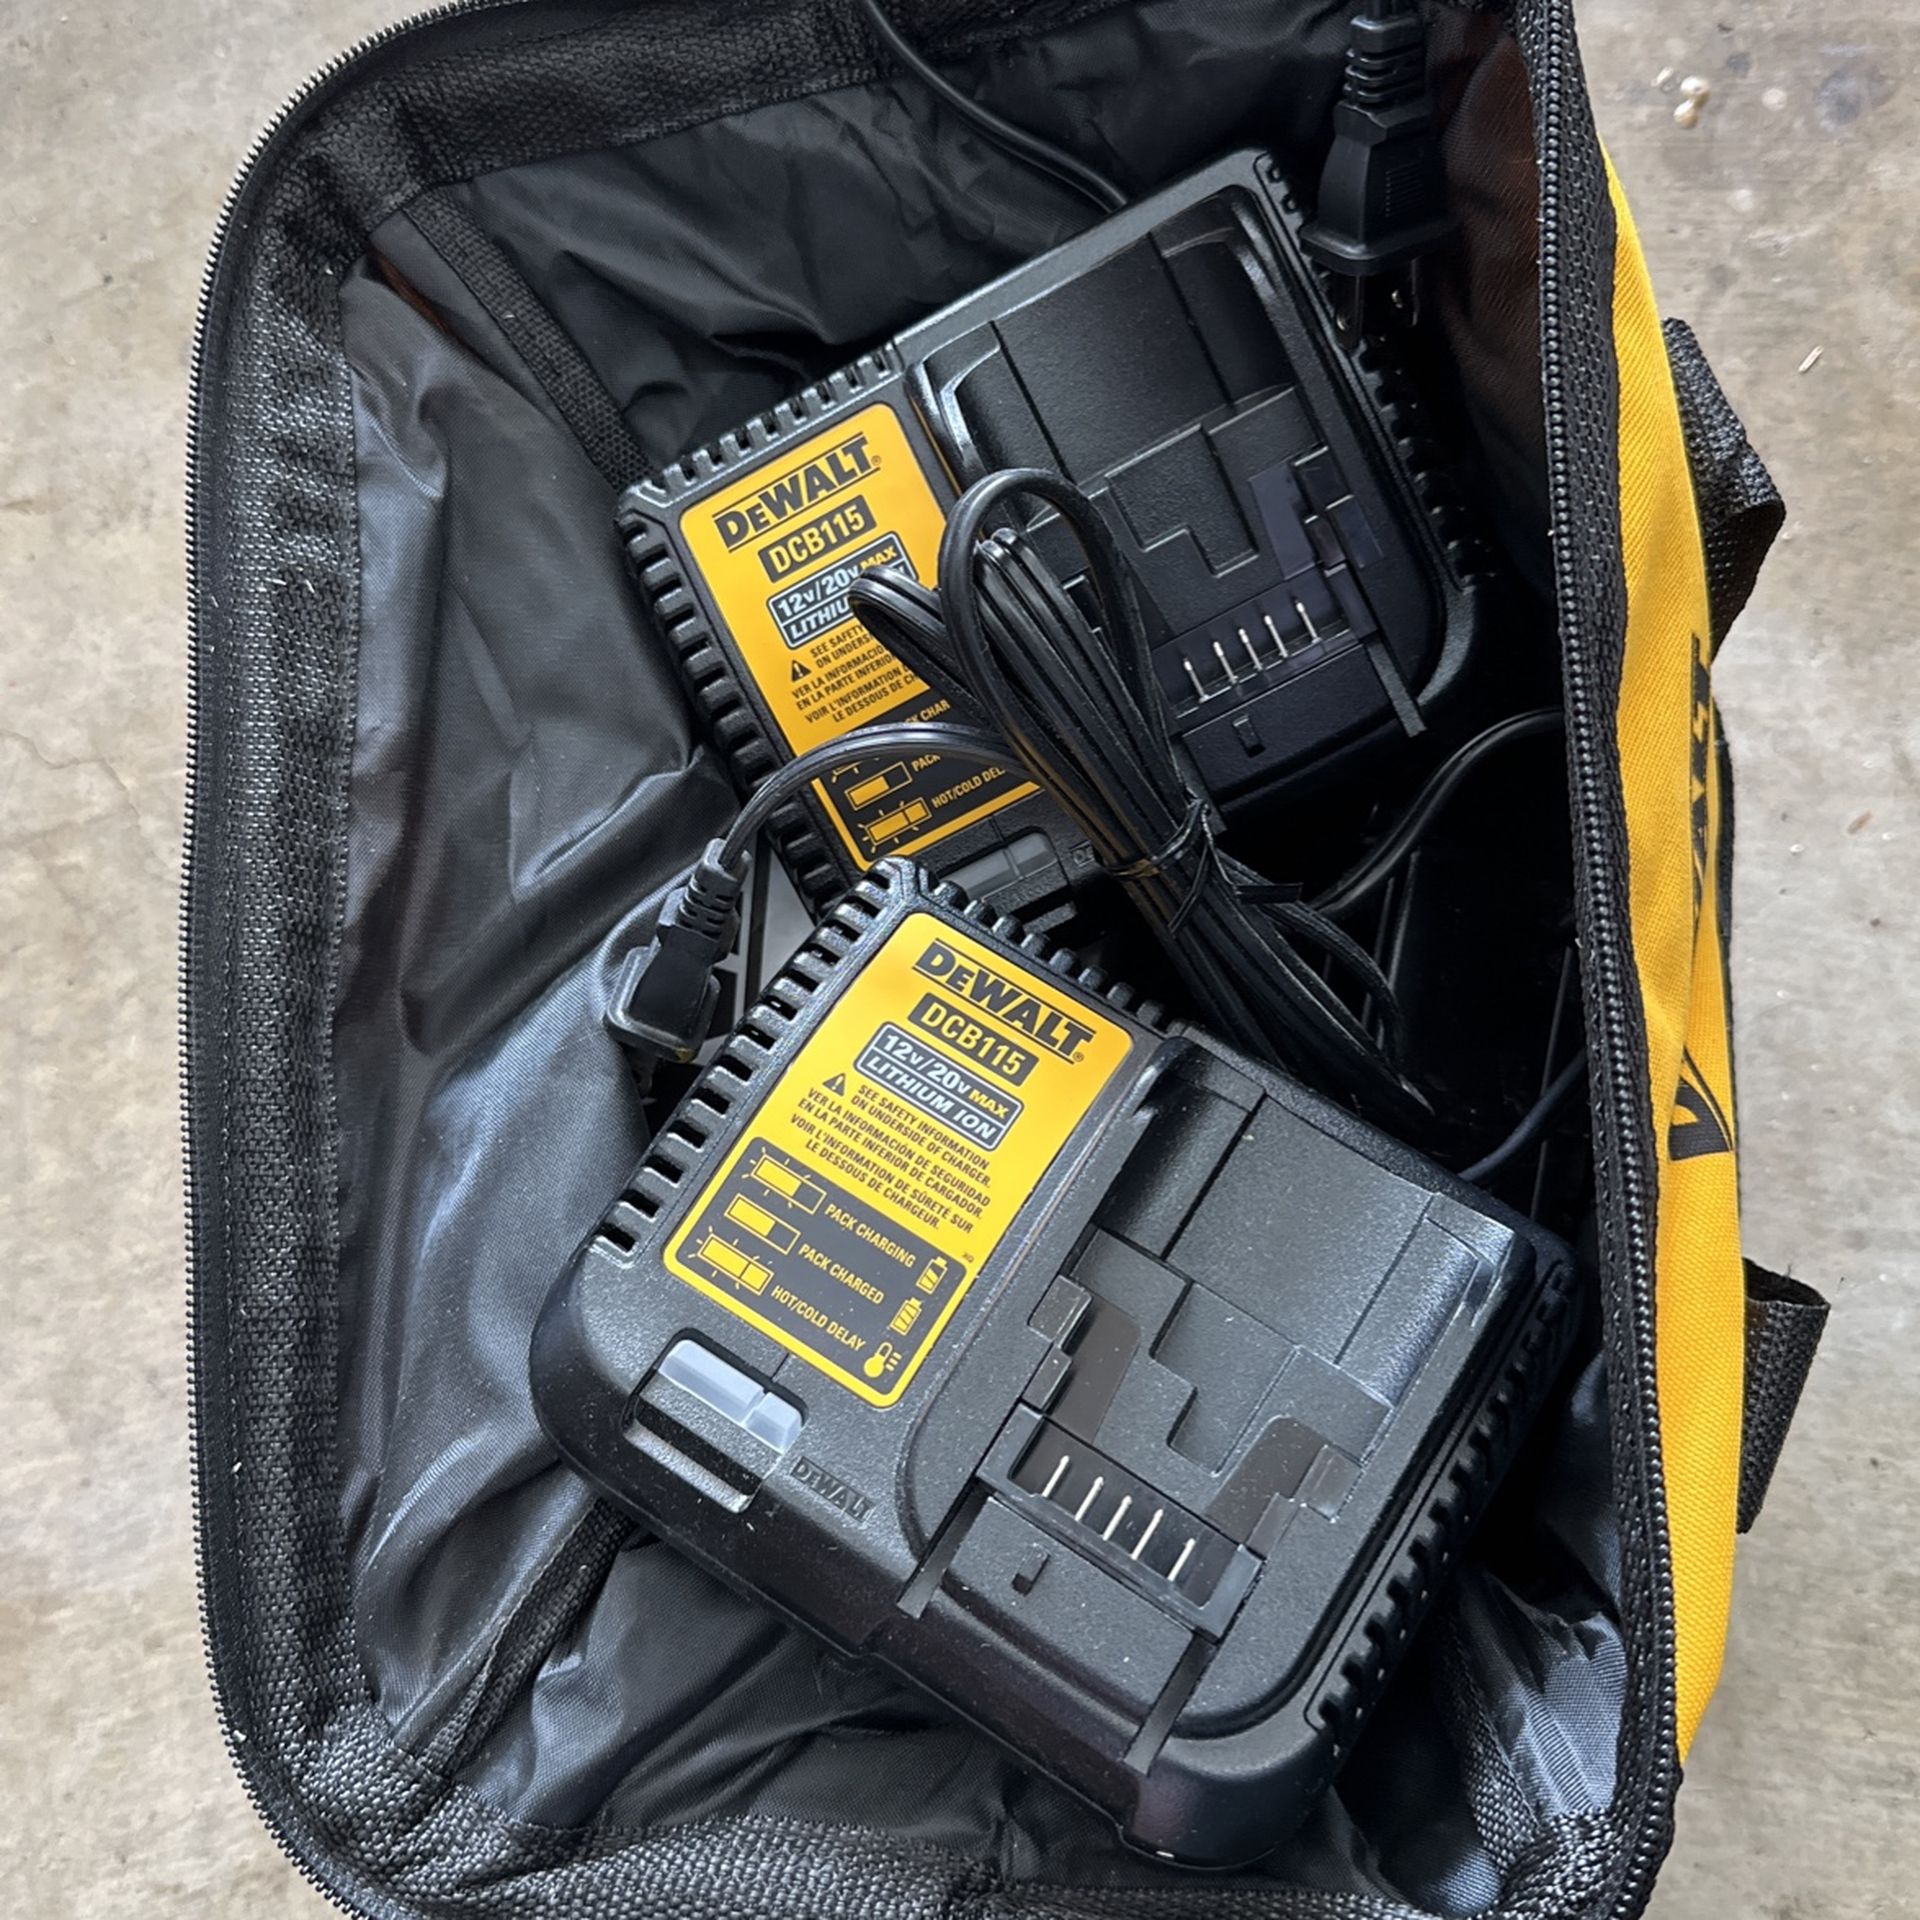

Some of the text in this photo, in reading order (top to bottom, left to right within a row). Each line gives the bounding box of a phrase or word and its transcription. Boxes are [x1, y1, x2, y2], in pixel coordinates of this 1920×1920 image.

[713, 436, 876, 548] DEWALT
[768, 504, 864, 572] DCB115
[790, 597, 849, 638] LITHIU
[810, 623, 863, 658] SEE SAFETY
[796, 697, 811, 710] EN
[810, 690, 824, 702] LA
[824, 674, 854, 695] PARTE
[854, 650, 894, 678] INFERIO
[816, 634, 870, 668] ON UNDERS
[791, 684, 811, 698] VER
[810, 676, 825, 688] LA
[805, 706, 829, 722] VOIR
[828, 667, 902, 710] L'INFORMATION
[832, 710, 845, 722] LE
[844, 687, 889, 715] DESSOUS
[889, 679, 903, 692] DE
[920, 699, 950, 720] CHAR
[931, 767, 1005, 807] HOT/COLD DEL
[915, 941, 1093, 1060] DEWALT
[920, 1002, 1025, 1075] DCB115
[858, 1084, 989, 1170] SEE SAFETY INFORMATION
[866, 1056, 996, 1139] LITHIUM ION
[968, 1089, 1008, 1118] MAX
[790, 1113, 973, 1233] VOIR L'INFORMATION DE SÛRETÉ SUR
[797, 1098, 982, 1218] EN LA PARTE INFERIOR DE CARGADOR.
[807, 1087, 990, 1206] VER LA INFORMACIÓN DE SEGURIDAD
[850, 1095, 990, 1188] ON UNDERSIDE OF CHARGER.
[805, 1138, 939, 1228] LE DESSOUS DE CHARGEUR.
[824, 1203, 915, 1267] PACK CHARGING
[798, 1243, 884, 1304] PACK CHARGED
[770, 1285, 866, 1351] HOT/COLD DELAY
